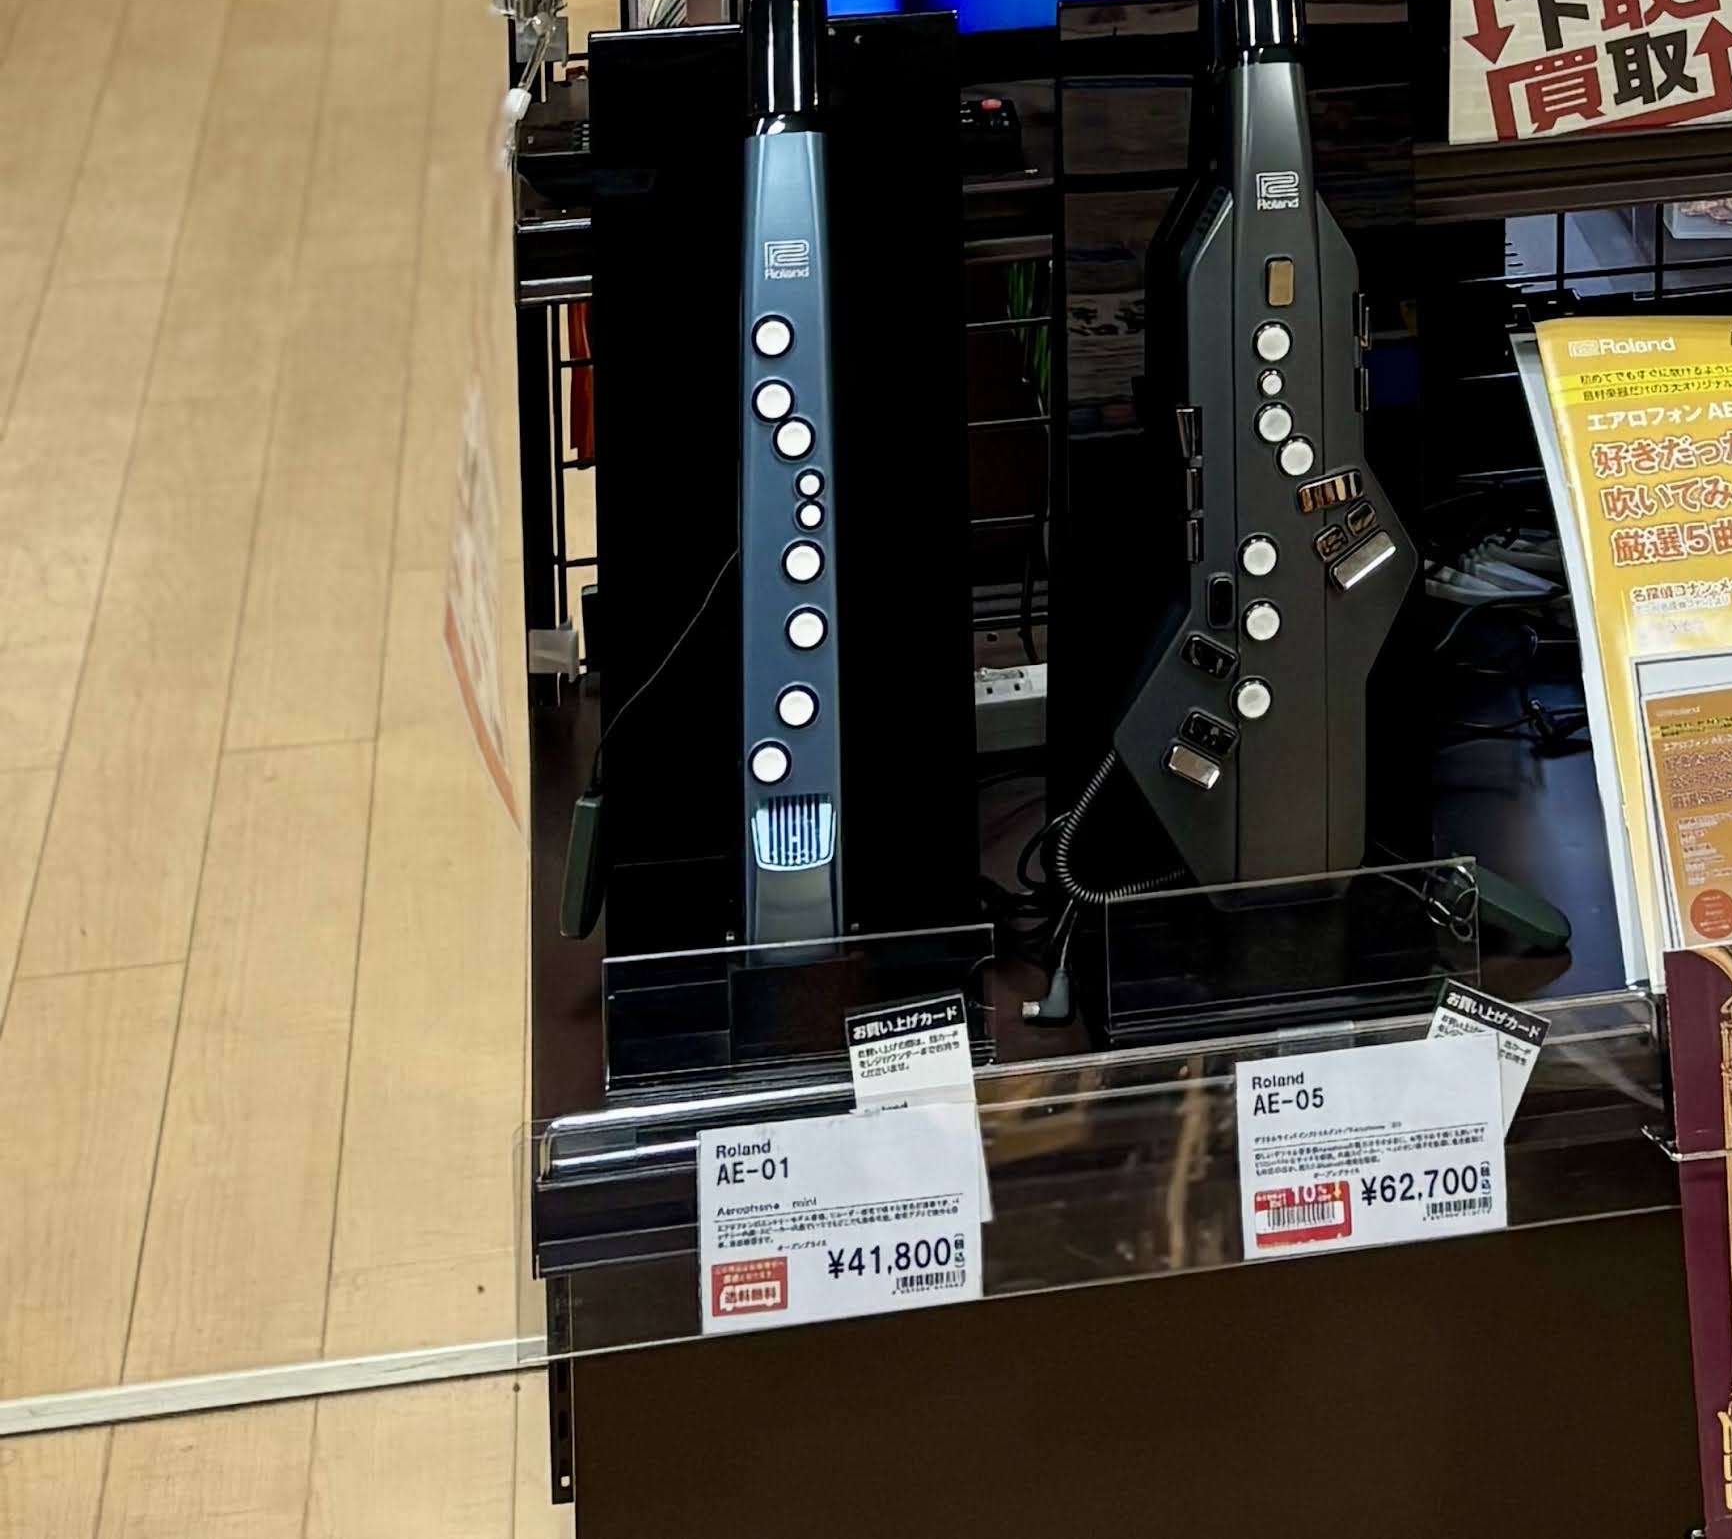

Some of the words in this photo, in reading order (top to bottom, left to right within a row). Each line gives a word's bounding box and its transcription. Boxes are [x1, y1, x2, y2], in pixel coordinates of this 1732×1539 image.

[1525, 29, 1699, 134] 買取
[1257, 198, 1299, 210] Roland
[765, 267, 809, 280] Roland
[1601, 337, 1676, 354] Roland
[1587, 405, 1702, 432] エアロフォン
[853, 1005, 958, 1041] お買い上げカード
[1447, 990, 1541, 1039] お買い上げカード
[1252, 1071, 1305, 1091] Roland
[1253, 1088, 1325, 1116] AE-05
[716, 1140, 771, 1159] Roland
[716, 1158, 790, 1186] AE-01
[1361, 1165, 1479, 1206] ¥62,700
[828, 1236, 951, 1279] ¥41,800
[724, 1286, 777, 1305] 送料無料
